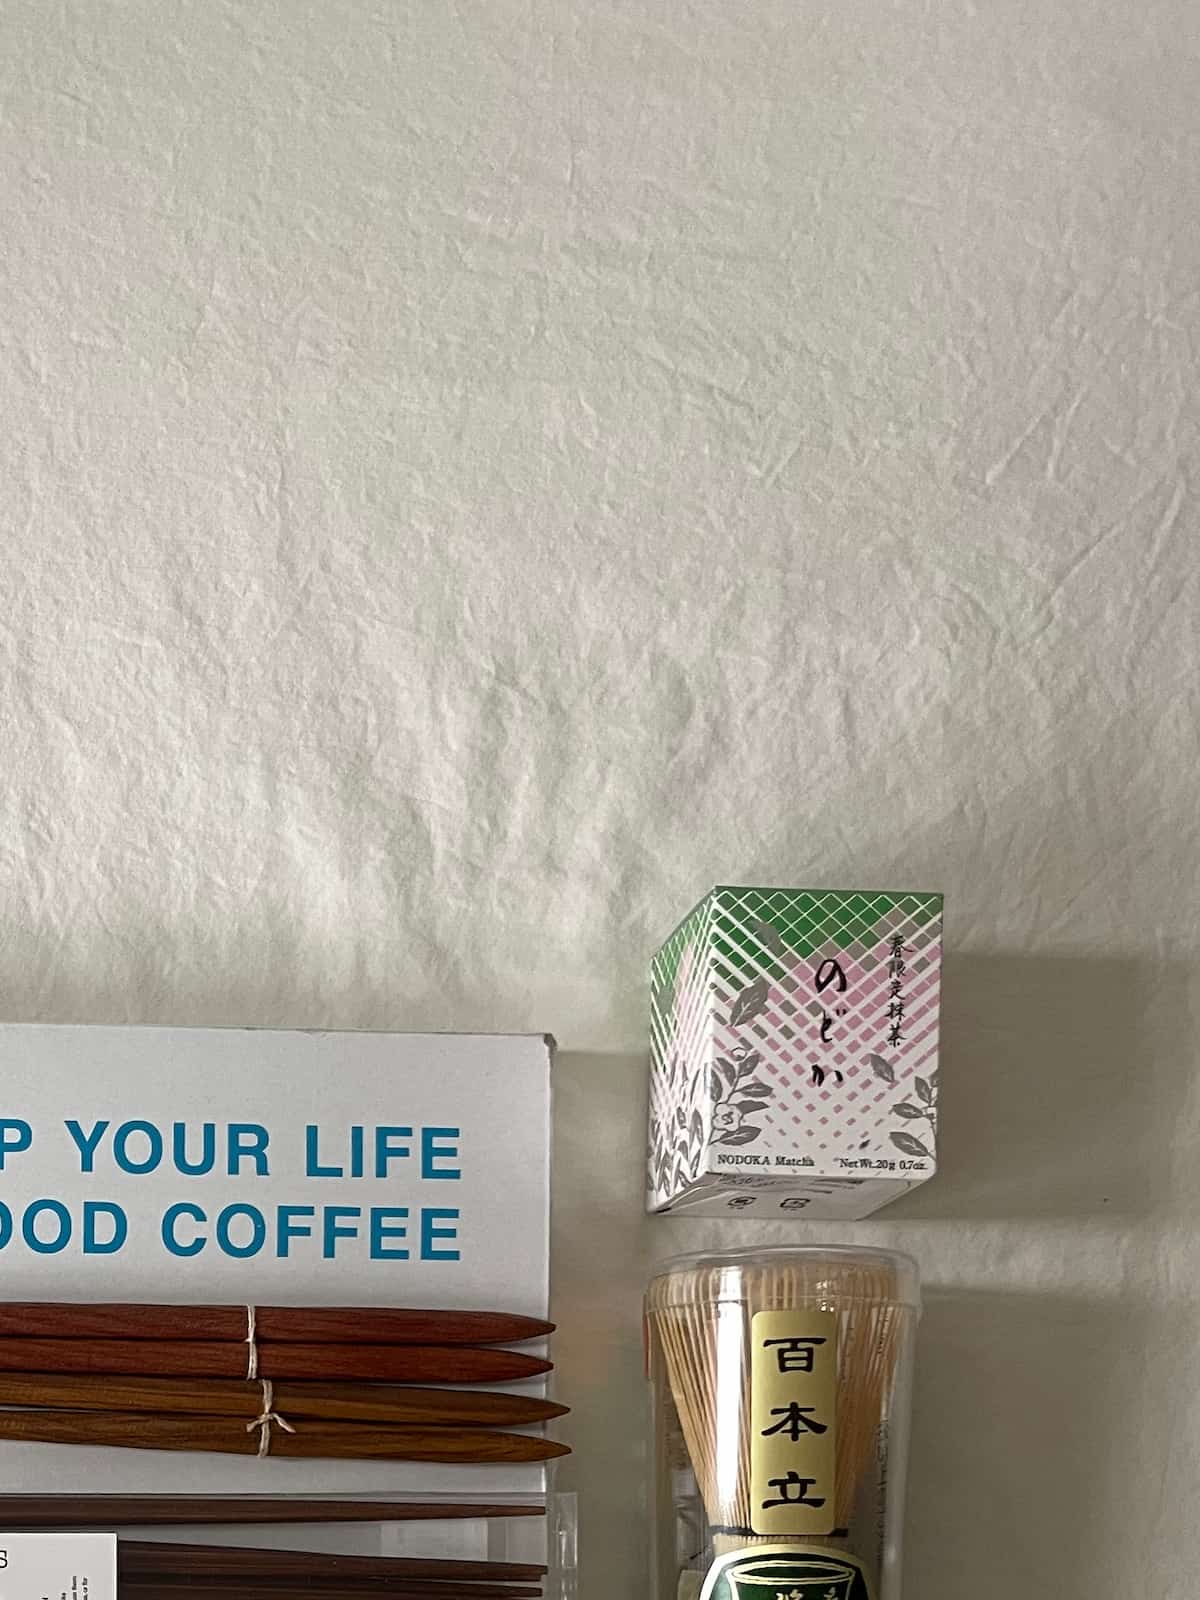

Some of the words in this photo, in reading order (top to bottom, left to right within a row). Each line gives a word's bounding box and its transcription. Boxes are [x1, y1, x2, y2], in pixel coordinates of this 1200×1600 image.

[811, 959, 848, 1087] のどか
[65, 1120, 270, 1178] YOUR
[304, 1124, 462, 1180] LIFE
[717, 1154, 770, 1166] NODOKA
[161, 1202, 461, 1262] COFFEE
[760, 1336, 828, 1509] 百本立
